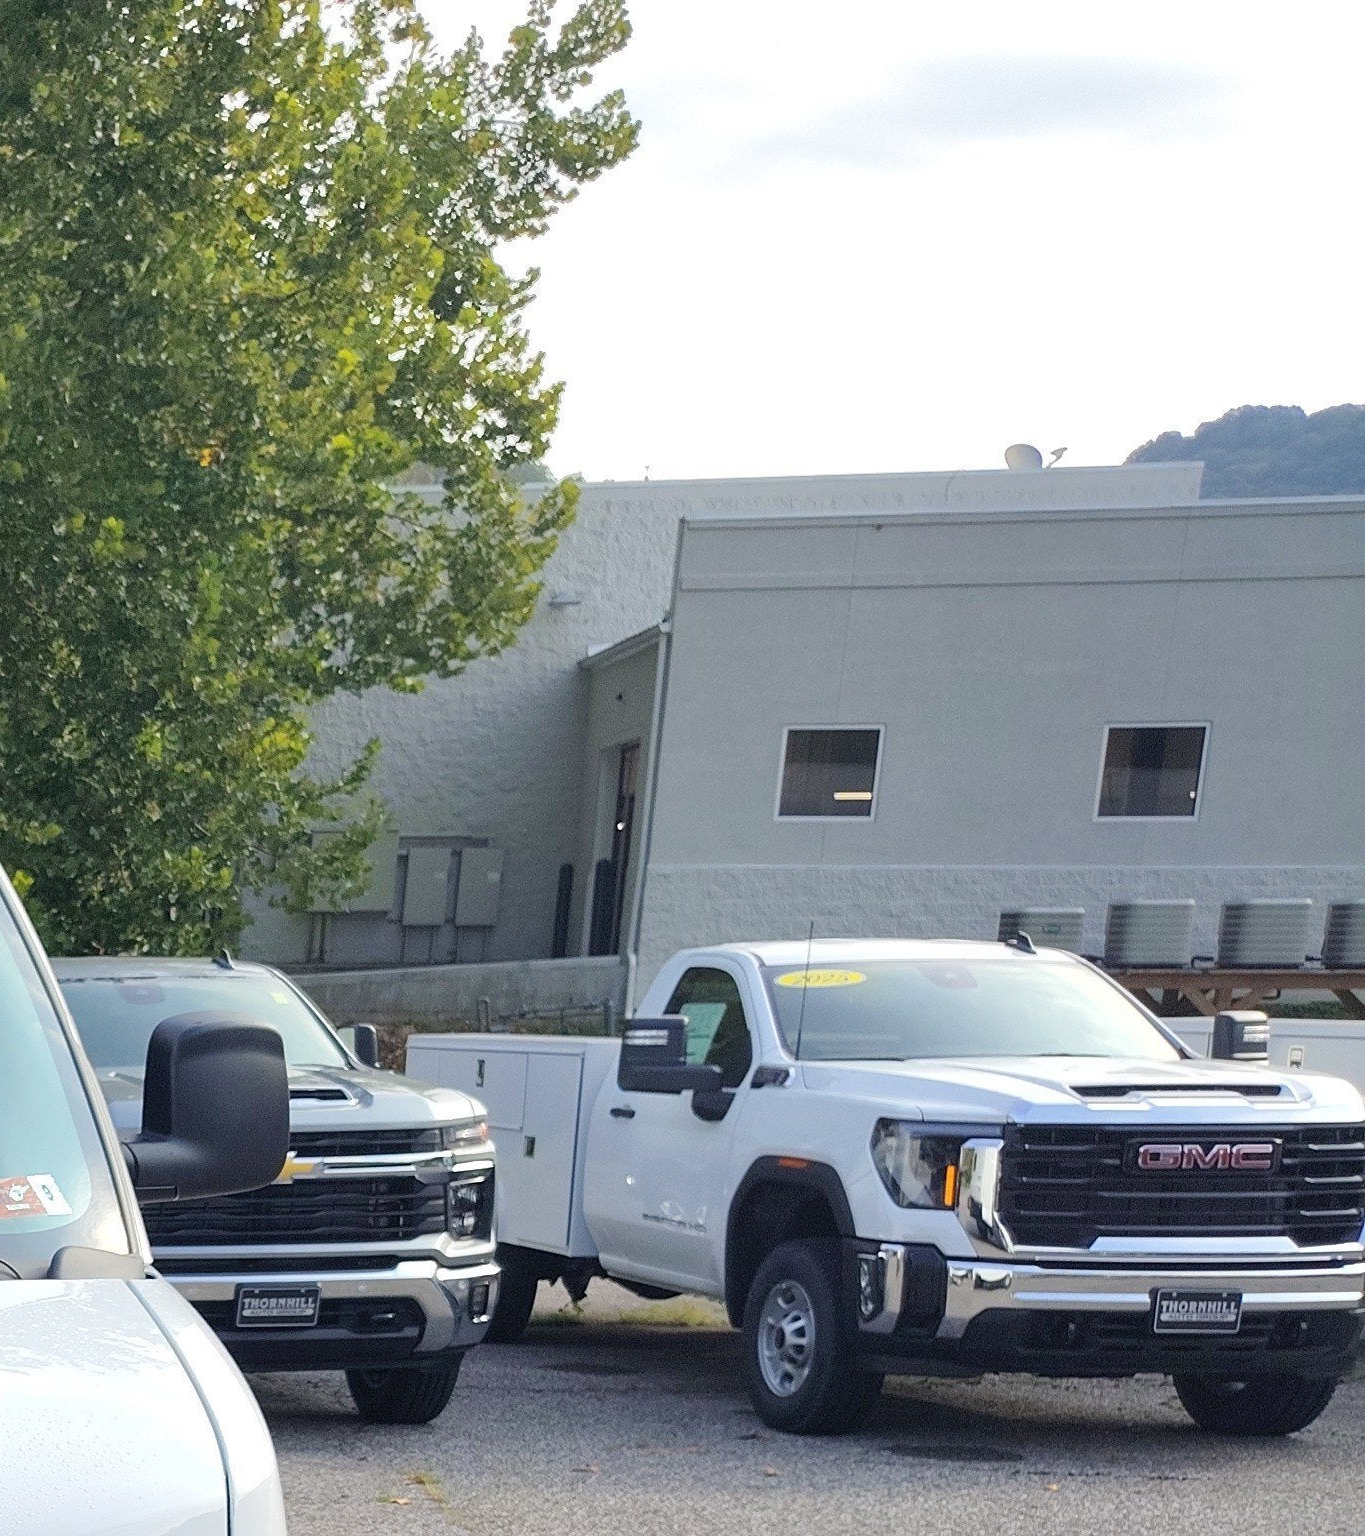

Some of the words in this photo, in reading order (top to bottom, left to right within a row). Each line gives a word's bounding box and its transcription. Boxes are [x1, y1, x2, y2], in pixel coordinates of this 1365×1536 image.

[1138, 1144, 1272, 1169] GMC
[243, 1297, 315, 1309] THORNHILL
[1161, 1300, 1237, 1314] THORNHILL
